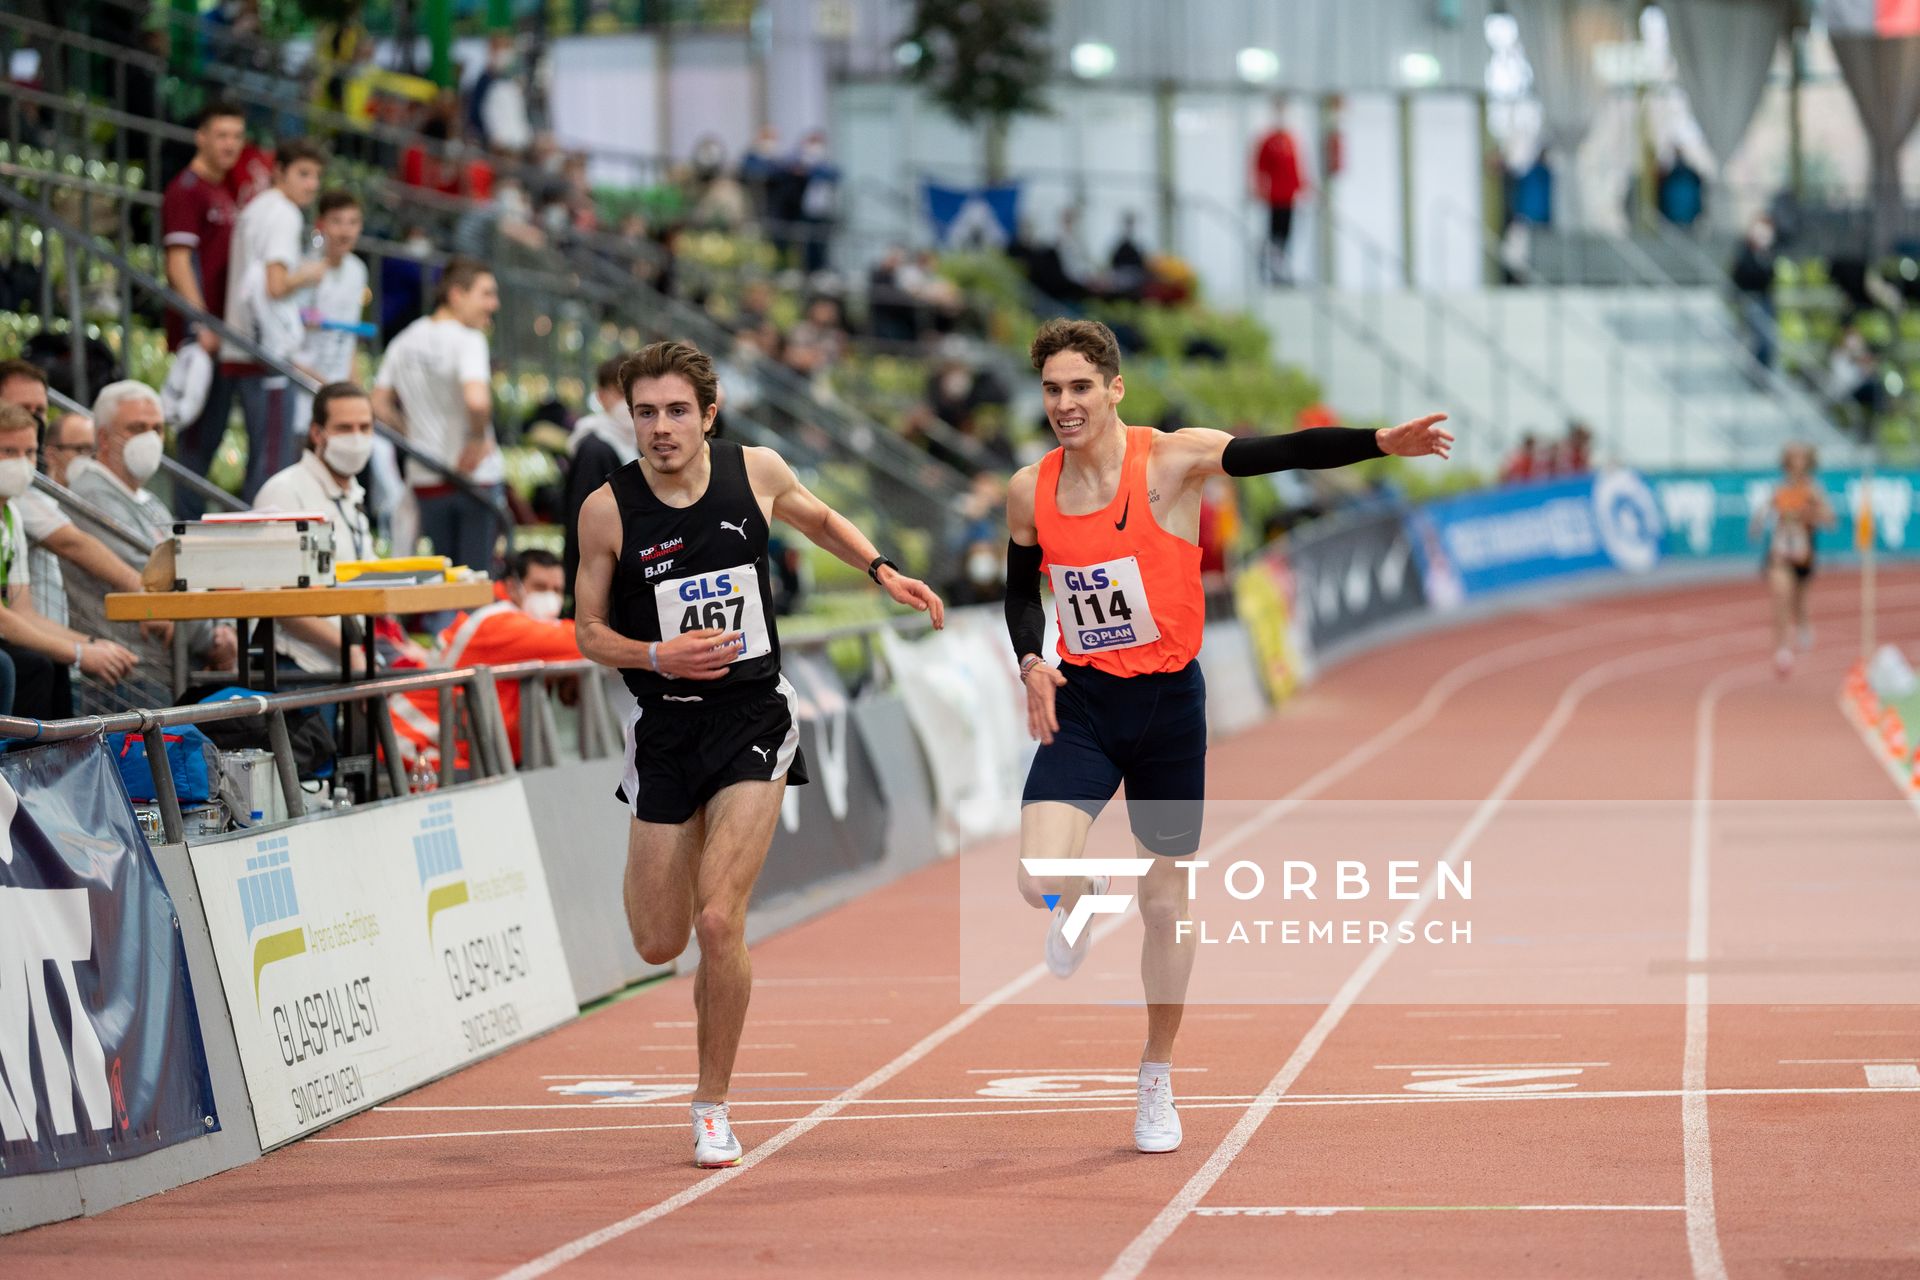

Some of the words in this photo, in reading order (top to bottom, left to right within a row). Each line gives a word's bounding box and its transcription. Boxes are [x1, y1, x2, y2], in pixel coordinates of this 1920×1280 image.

[639, 547, 655, 557] TOP
[660, 537, 683, 550] TEAM
[679, 595, 746, 635] 467
[1068, 590, 1133, 627] 114
[1100, 627, 1133, 640] PLAN
[444, 925, 531, 1001] GLASPALAST
[273, 976, 380, 1067] GLASPALAST
[291, 1064, 365, 1125] SINDELFINGEN
